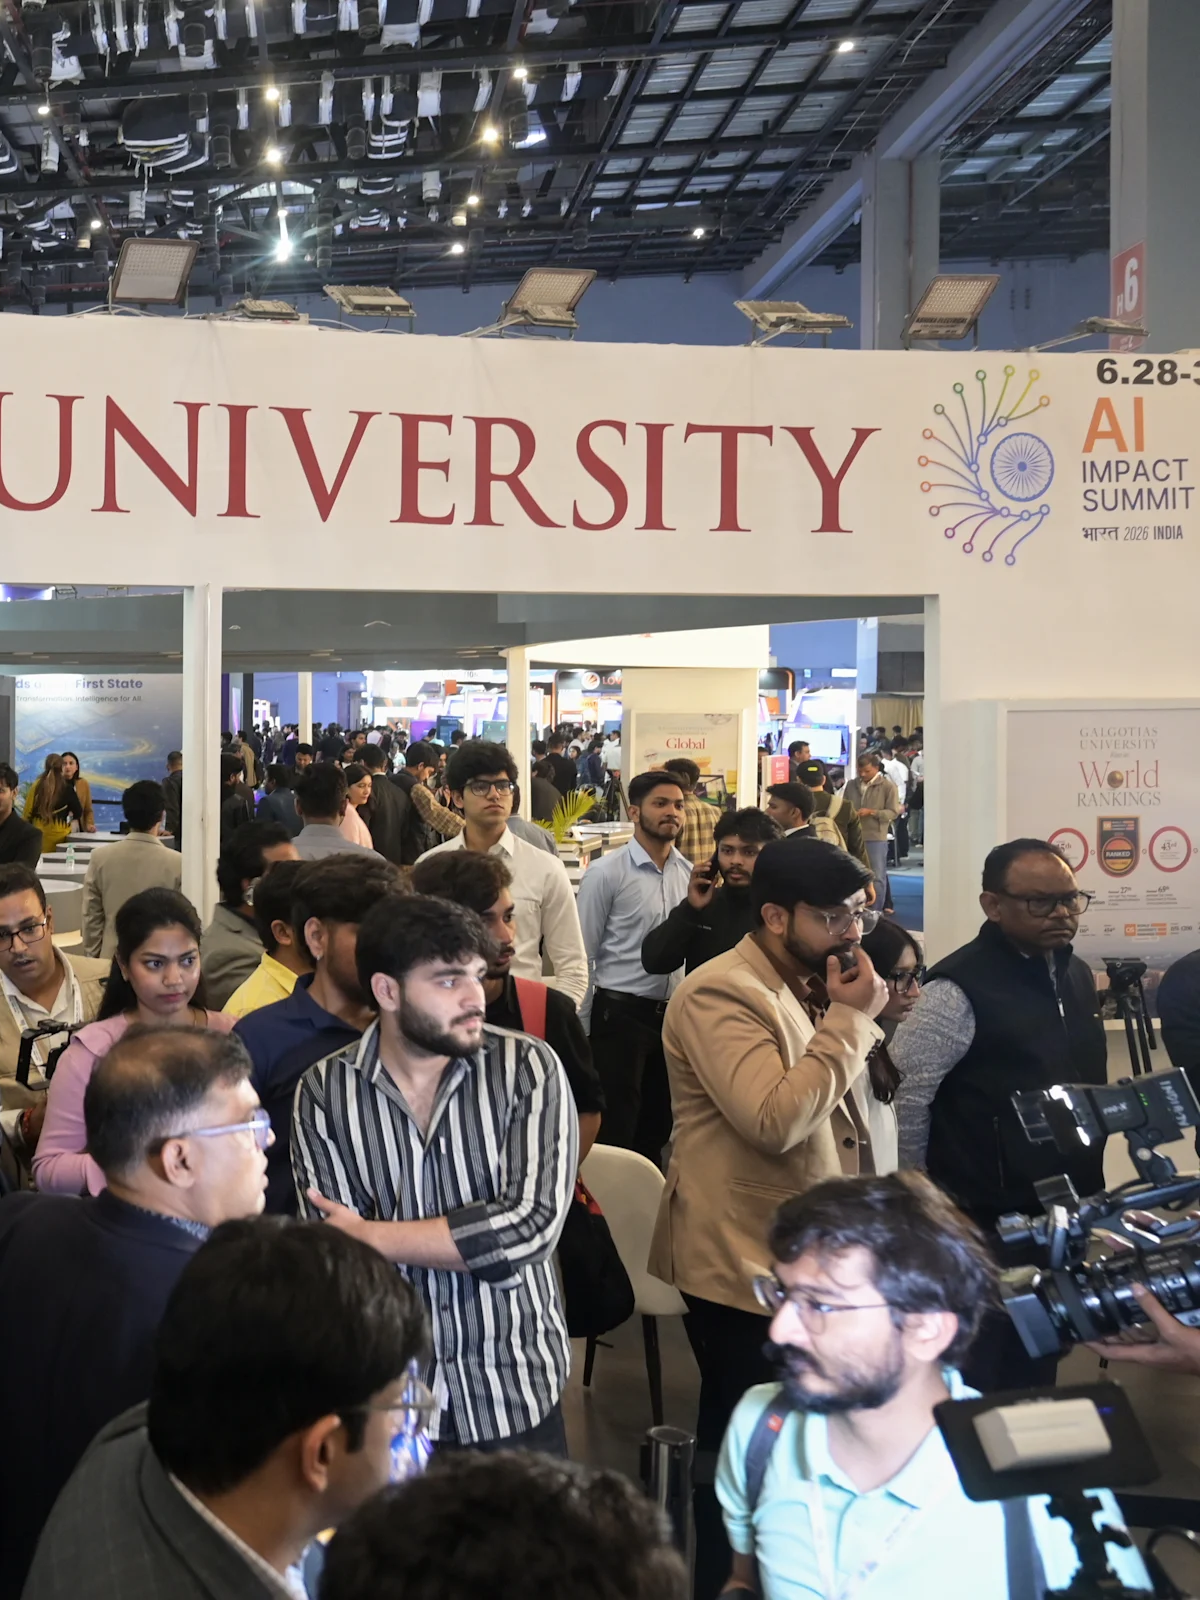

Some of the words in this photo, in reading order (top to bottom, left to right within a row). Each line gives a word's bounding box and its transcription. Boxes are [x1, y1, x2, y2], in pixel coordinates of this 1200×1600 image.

[1082, 396, 1145, 453] AI
[1082, 458, 1189, 484] IMPACT
[1082, 486, 1196, 512] SUMMIT
[1082, 526, 1120, 542] भारत
[1123, 525, 1150, 541] 2026
[1153, 524, 1184, 540] INDIA
[107, 679, 143, 689] State
[75, 695, 119, 704] Intelligence
[1080, 727, 1158, 738] GALGOTIAS
[666, 738, 705, 750] Global
[1080, 739, 1157, 750] UNIVERSITY
[1077, 791, 1161, 807] RANKINGS
